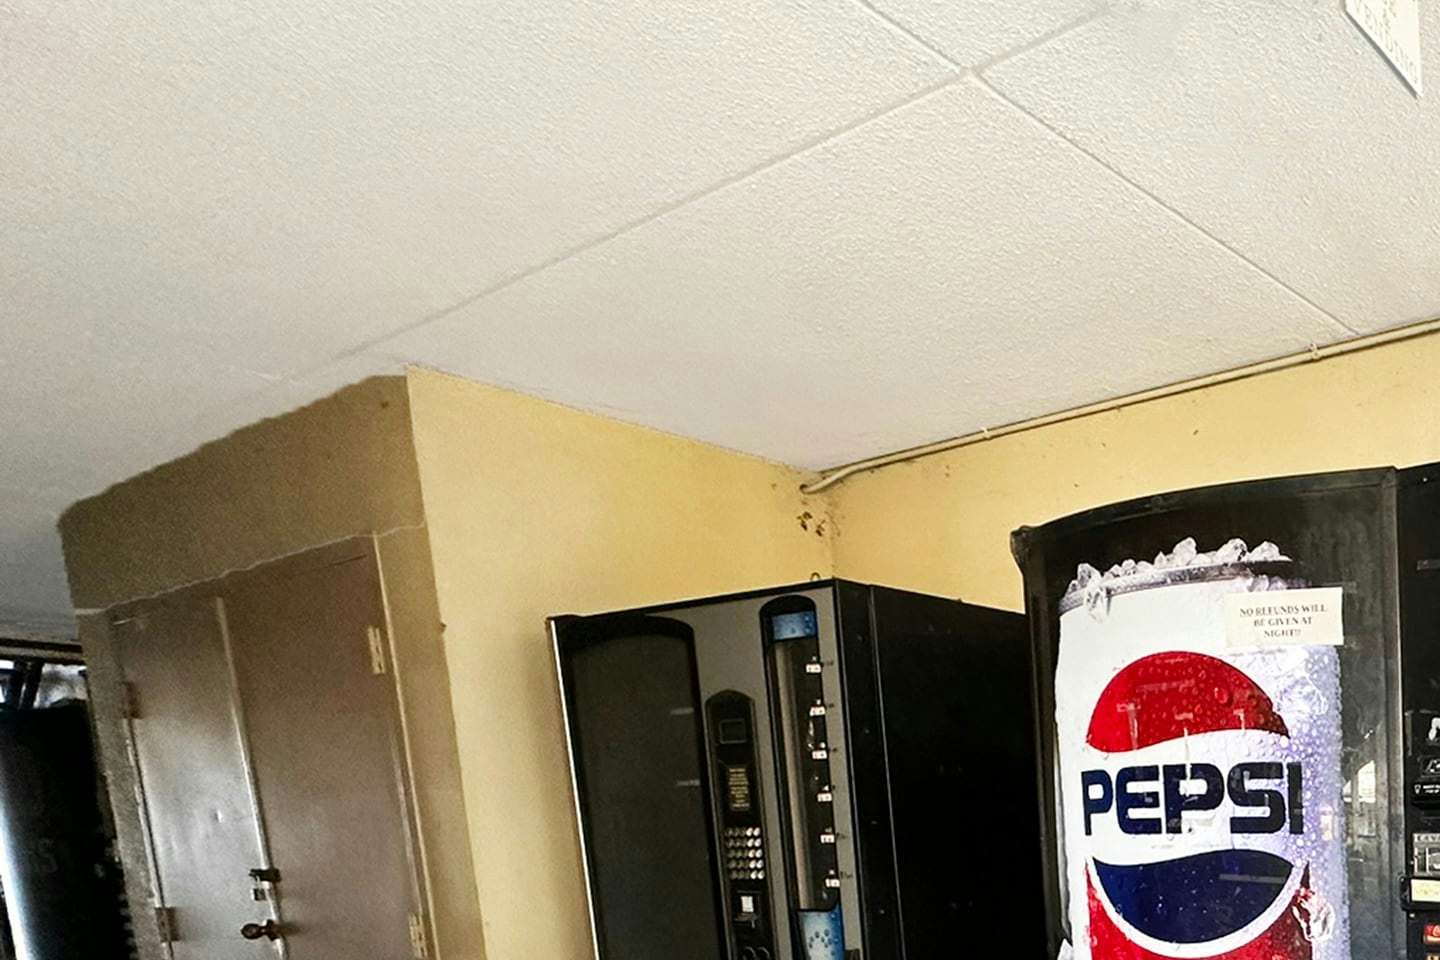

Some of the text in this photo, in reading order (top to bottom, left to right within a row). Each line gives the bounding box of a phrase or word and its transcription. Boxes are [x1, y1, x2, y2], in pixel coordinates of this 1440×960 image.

[1239, 603, 1328, 617] NO REFUNDS WILL
[1267, 617, 1299, 627] GIVEN
[1301, 616, 1312, 625] AT
[1080, 761, 1305, 836] PEPSI
